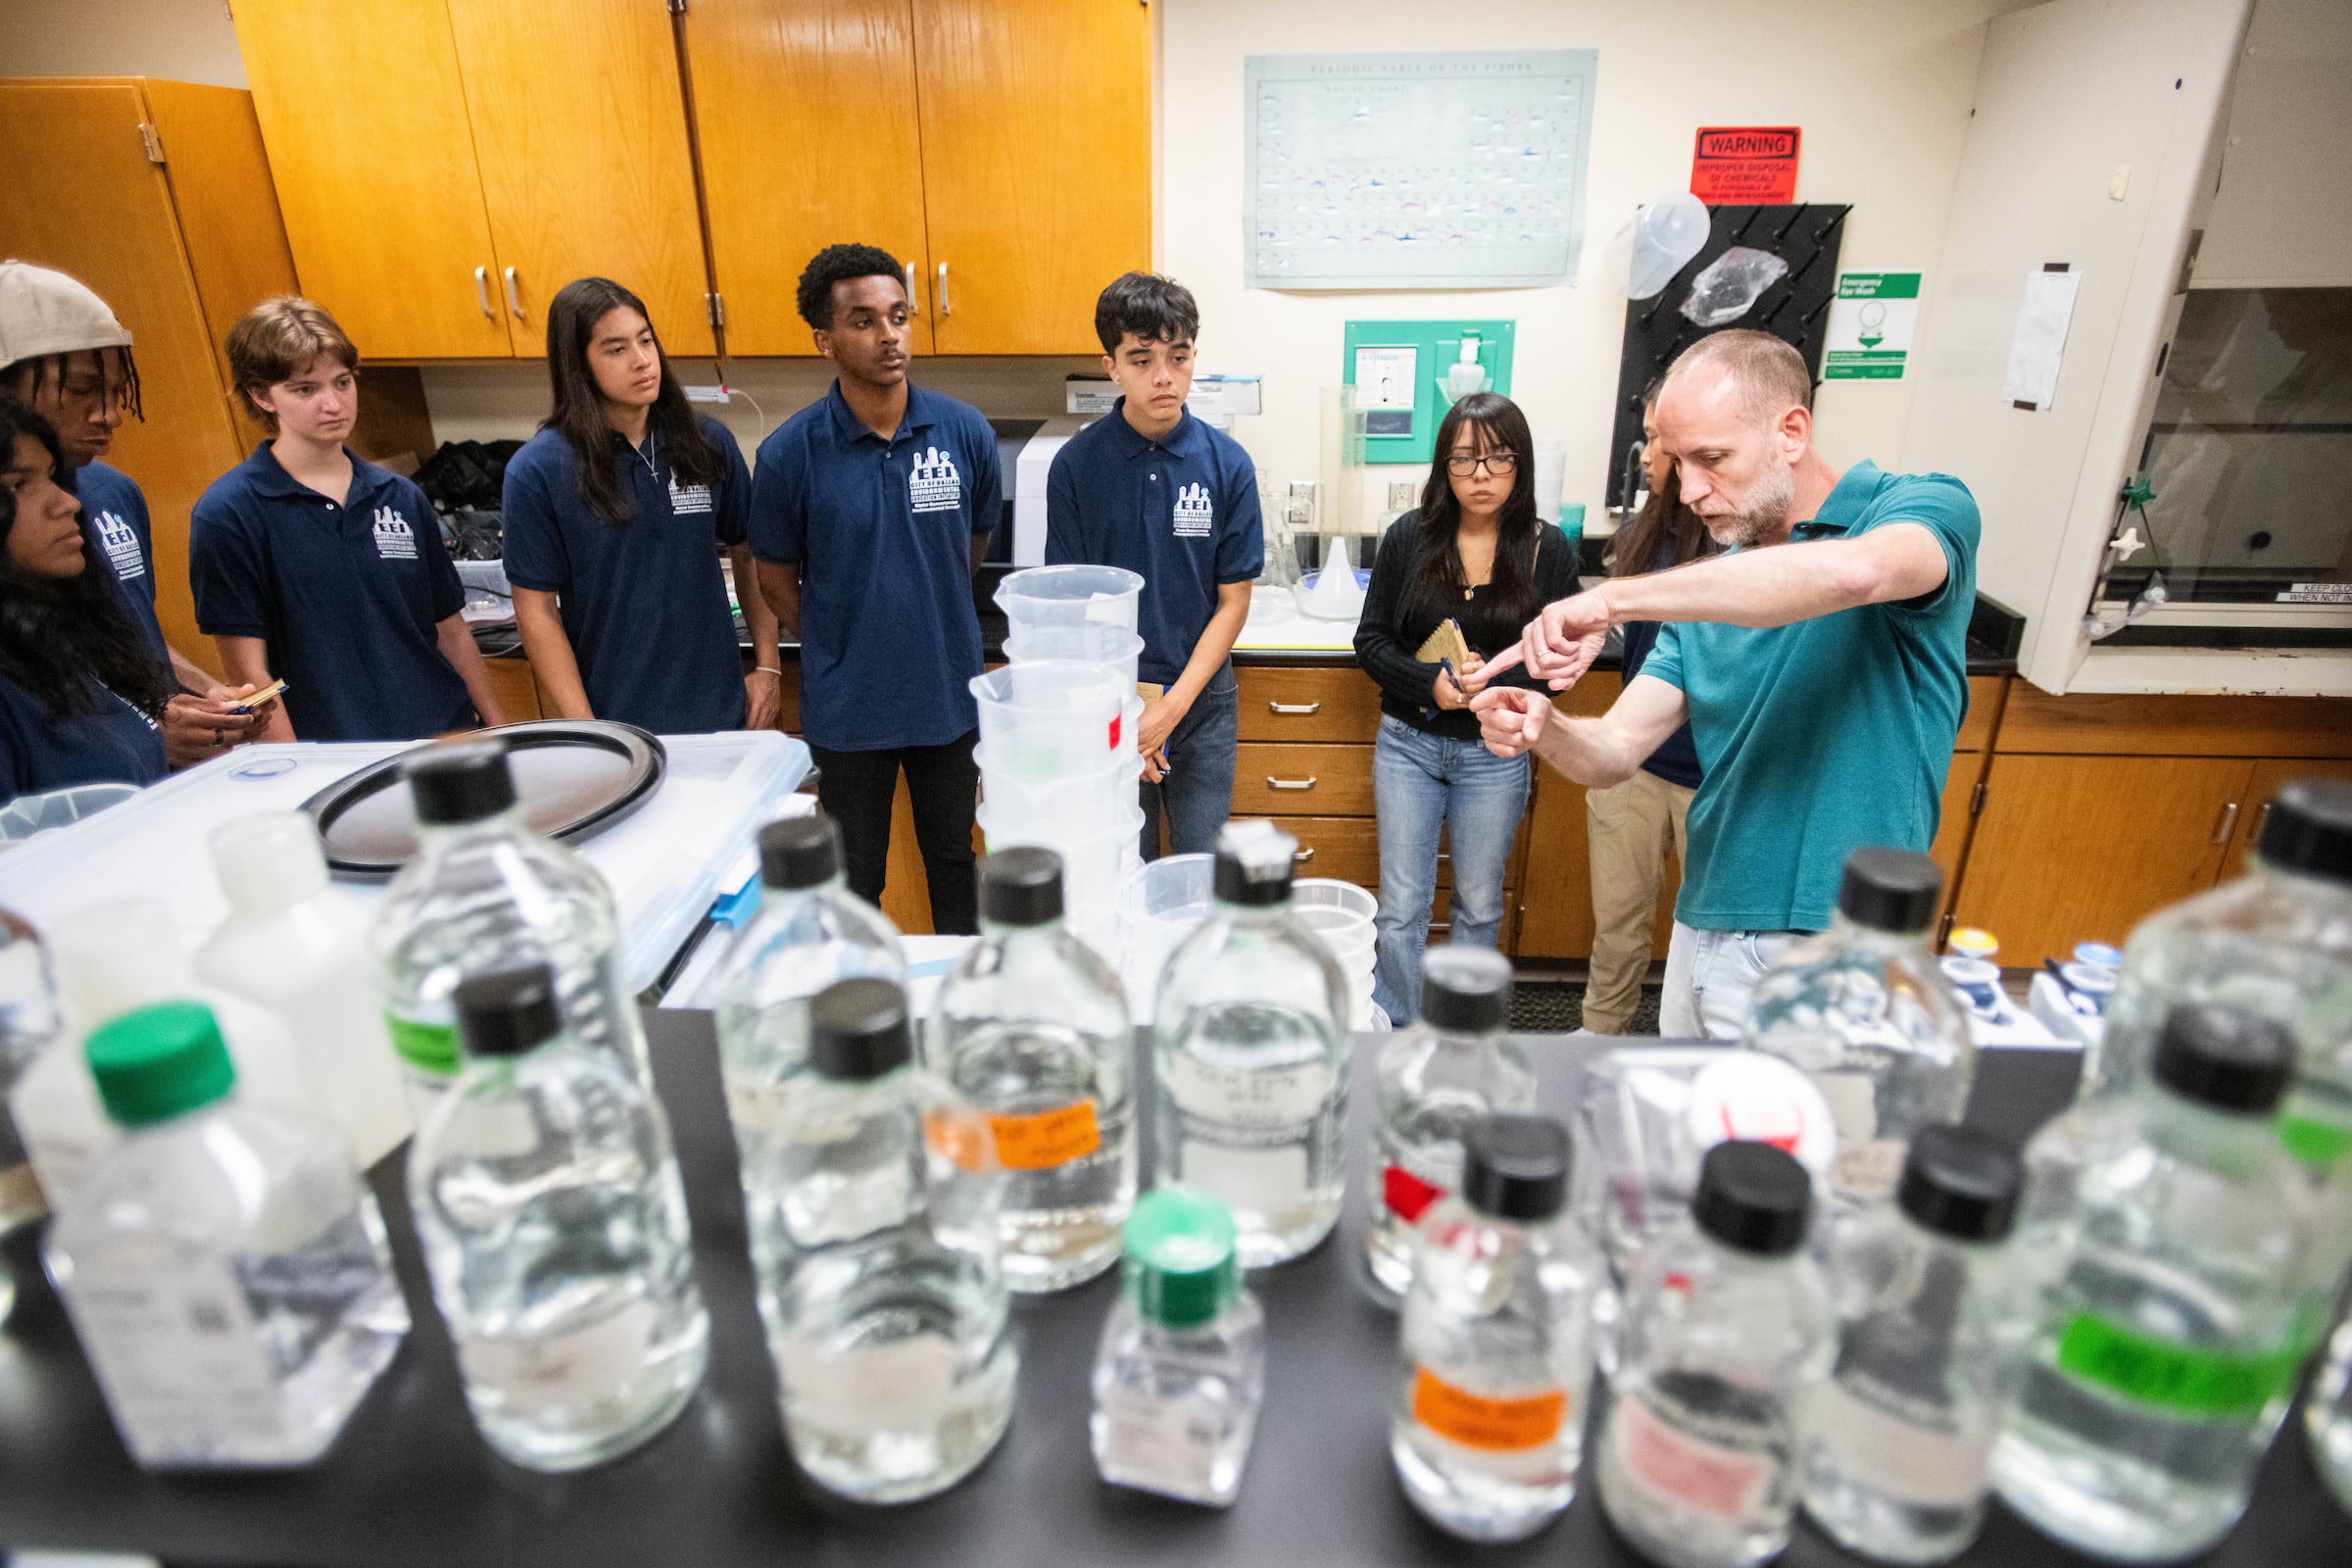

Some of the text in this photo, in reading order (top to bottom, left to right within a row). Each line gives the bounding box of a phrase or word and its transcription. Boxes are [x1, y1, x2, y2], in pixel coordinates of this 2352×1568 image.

[1710, 136, 1786, 152] WARNING
[1841, 278, 1883, 287] Emergency
[917, 466, 952, 480] EEI
[1181, 500, 1207, 510] EEI
[378, 522, 406, 533] EEI
[105, 528, 133, 546] EEI
